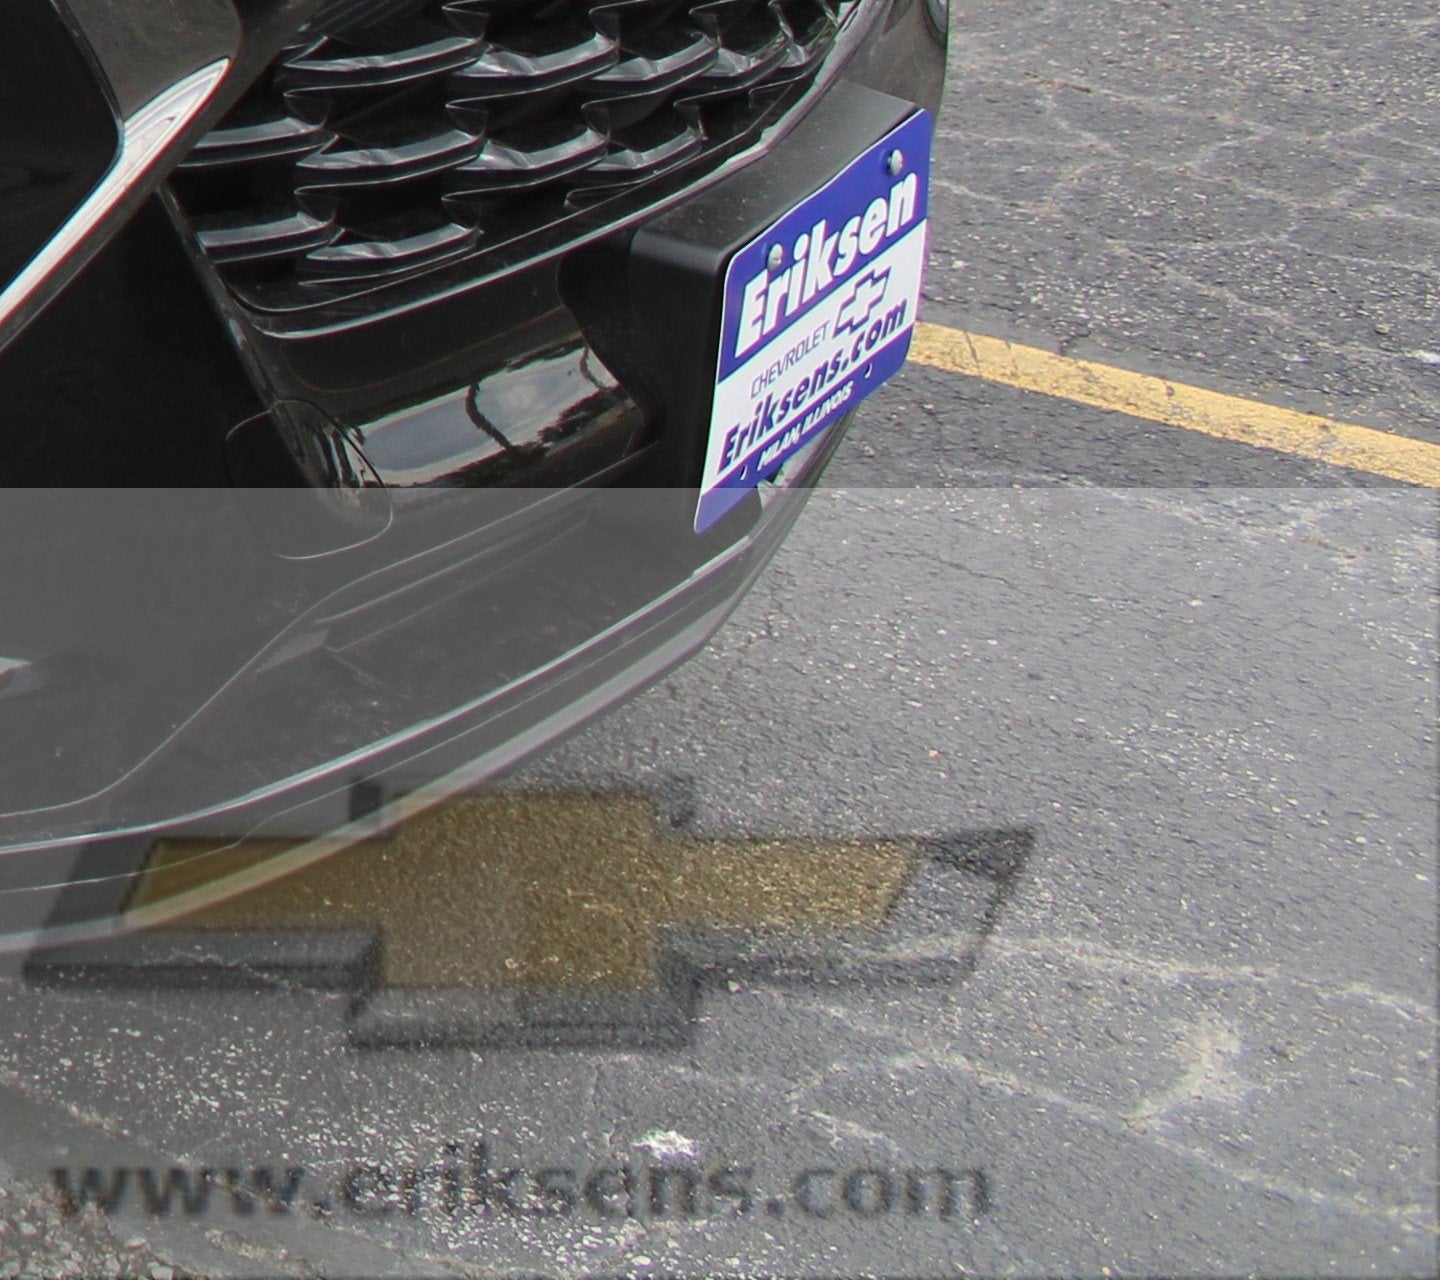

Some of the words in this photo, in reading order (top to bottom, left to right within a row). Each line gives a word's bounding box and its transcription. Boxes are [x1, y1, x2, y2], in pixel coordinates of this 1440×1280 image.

[735, 172, 918, 358] Eriksen
[717, 298, 908, 474] Eriksens.com
[750, 319, 830, 399] CHEVROLET
